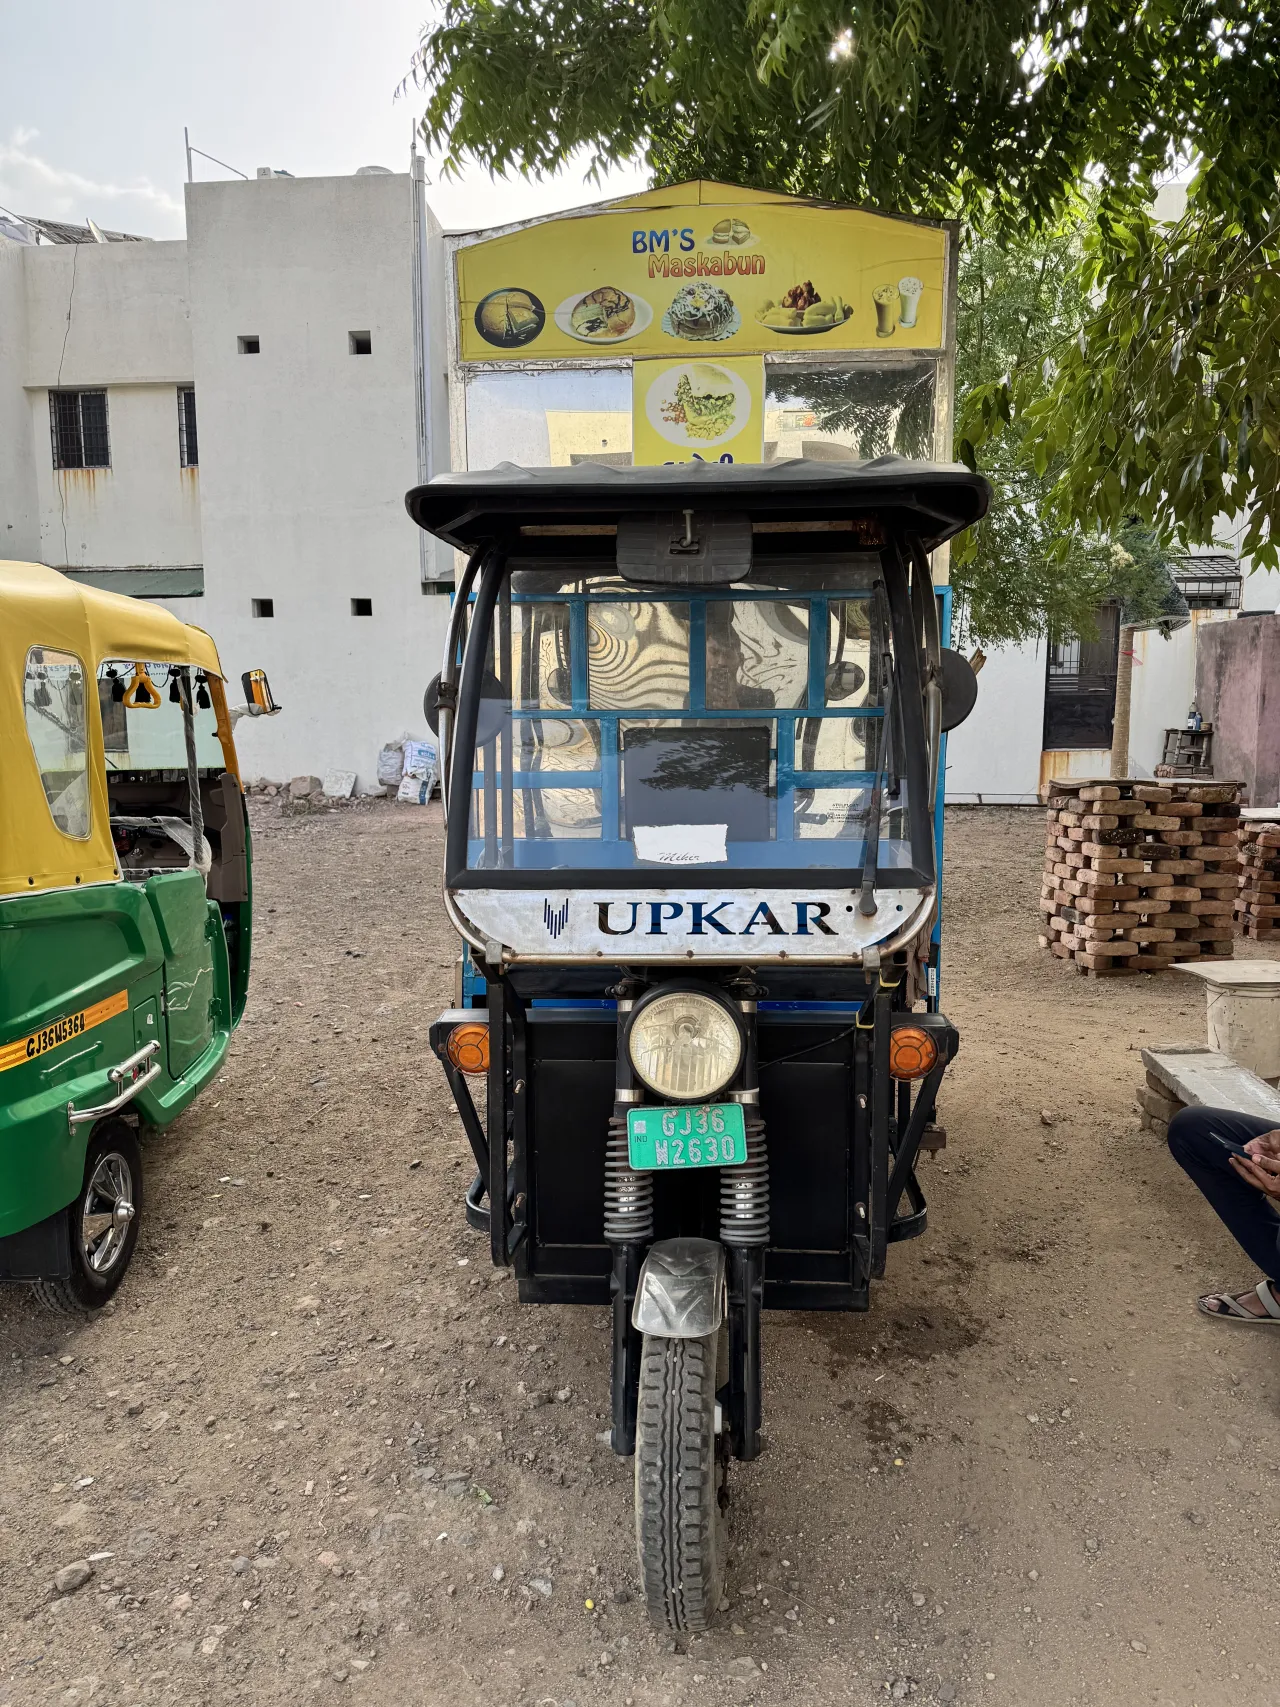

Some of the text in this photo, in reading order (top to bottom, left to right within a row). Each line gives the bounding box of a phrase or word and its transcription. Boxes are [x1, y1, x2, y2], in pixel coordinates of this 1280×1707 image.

[632, 228, 695, 253] BM'S
[648, 251, 765, 278] Maskabun
[594, 901, 839, 935] UPKAR
[26, 1013, 85, 1057] GJ36W5364
[662, 1107, 725, 1137] GJ36
[634, 1135, 648, 1143] IND
[655, 1135, 735, 1165] W2630
